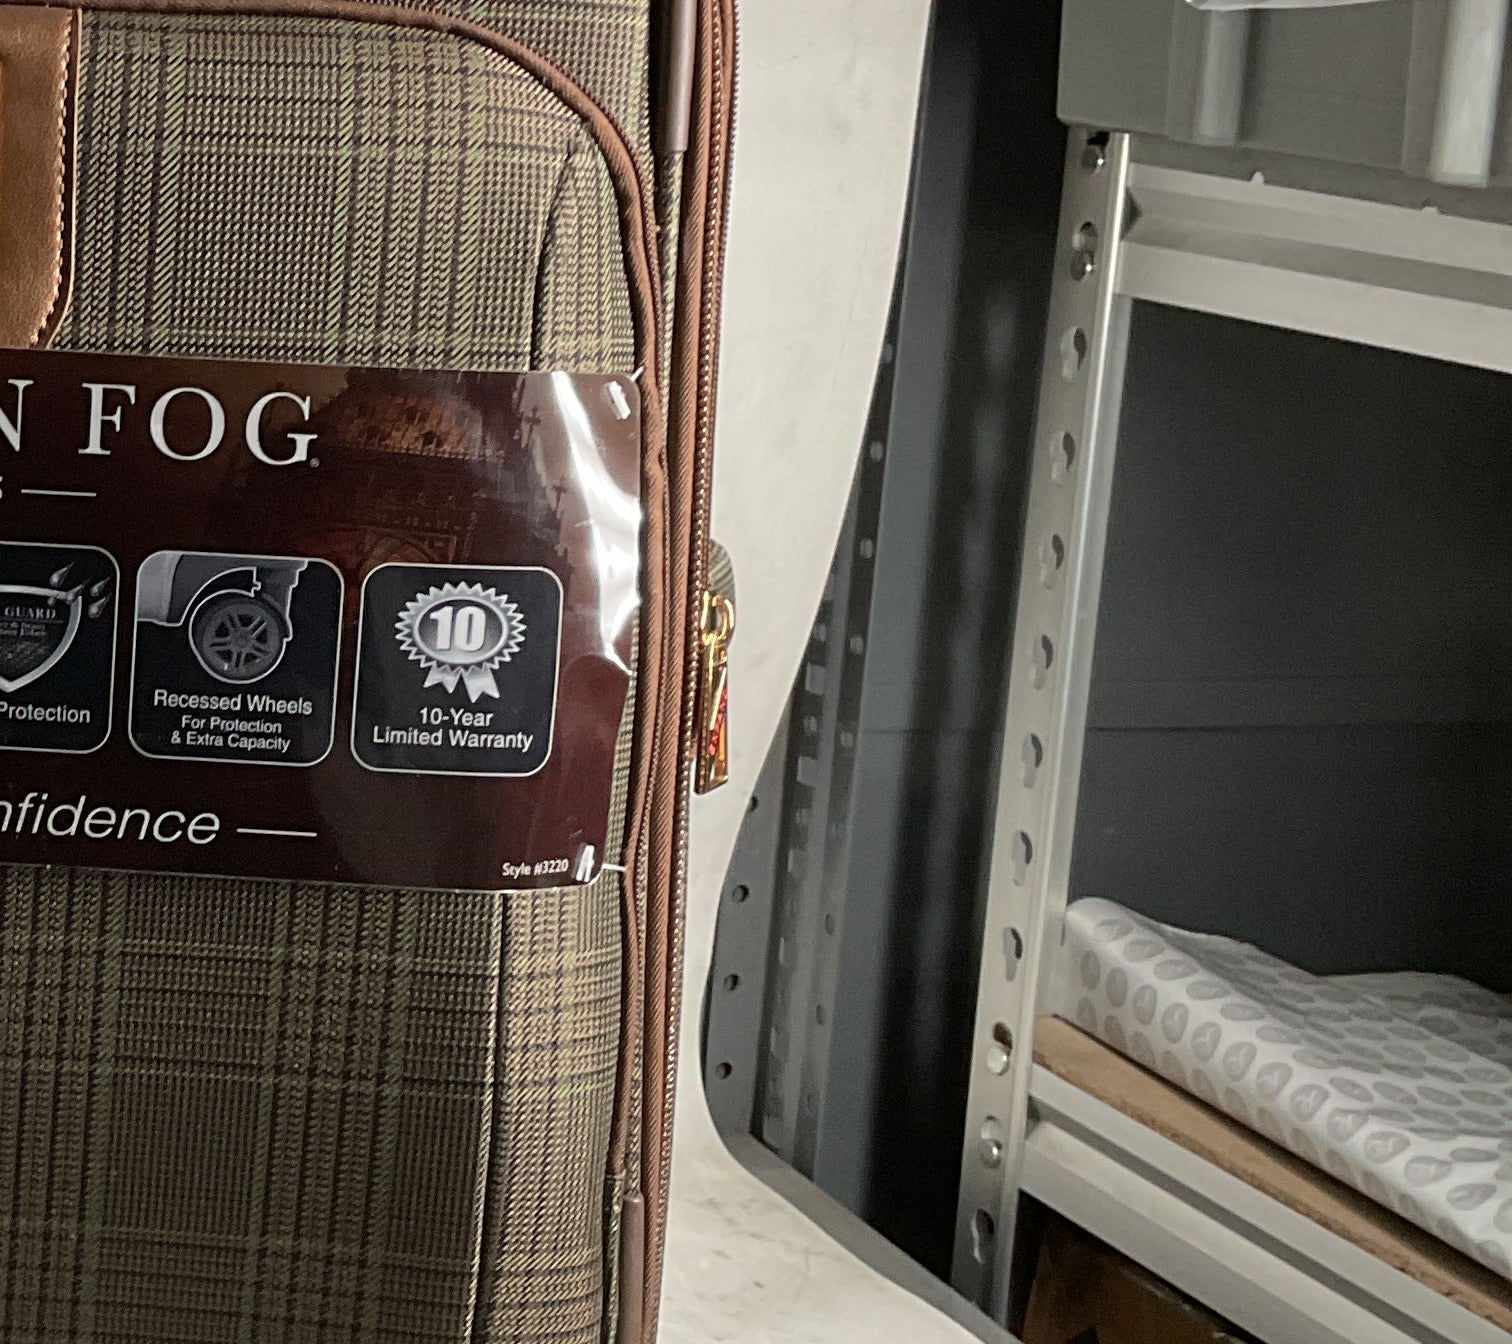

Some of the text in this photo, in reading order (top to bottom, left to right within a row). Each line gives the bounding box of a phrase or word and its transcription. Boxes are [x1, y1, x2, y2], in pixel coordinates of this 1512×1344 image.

[78, 382, 319, 468] FOG
[4, 606, 57, 620] GUARD
[429, 605, 487, 652] 10
[153, 688, 314, 716] Recessed Wheels
[181, 714, 283, 734] For Protection
[419, 706, 495, 727] 10-Year
[170, 729, 292, 754] & Extra Capacity
[372, 725, 534, 753] Limited Warranty
[502, 858, 569, 879] Style #3220
